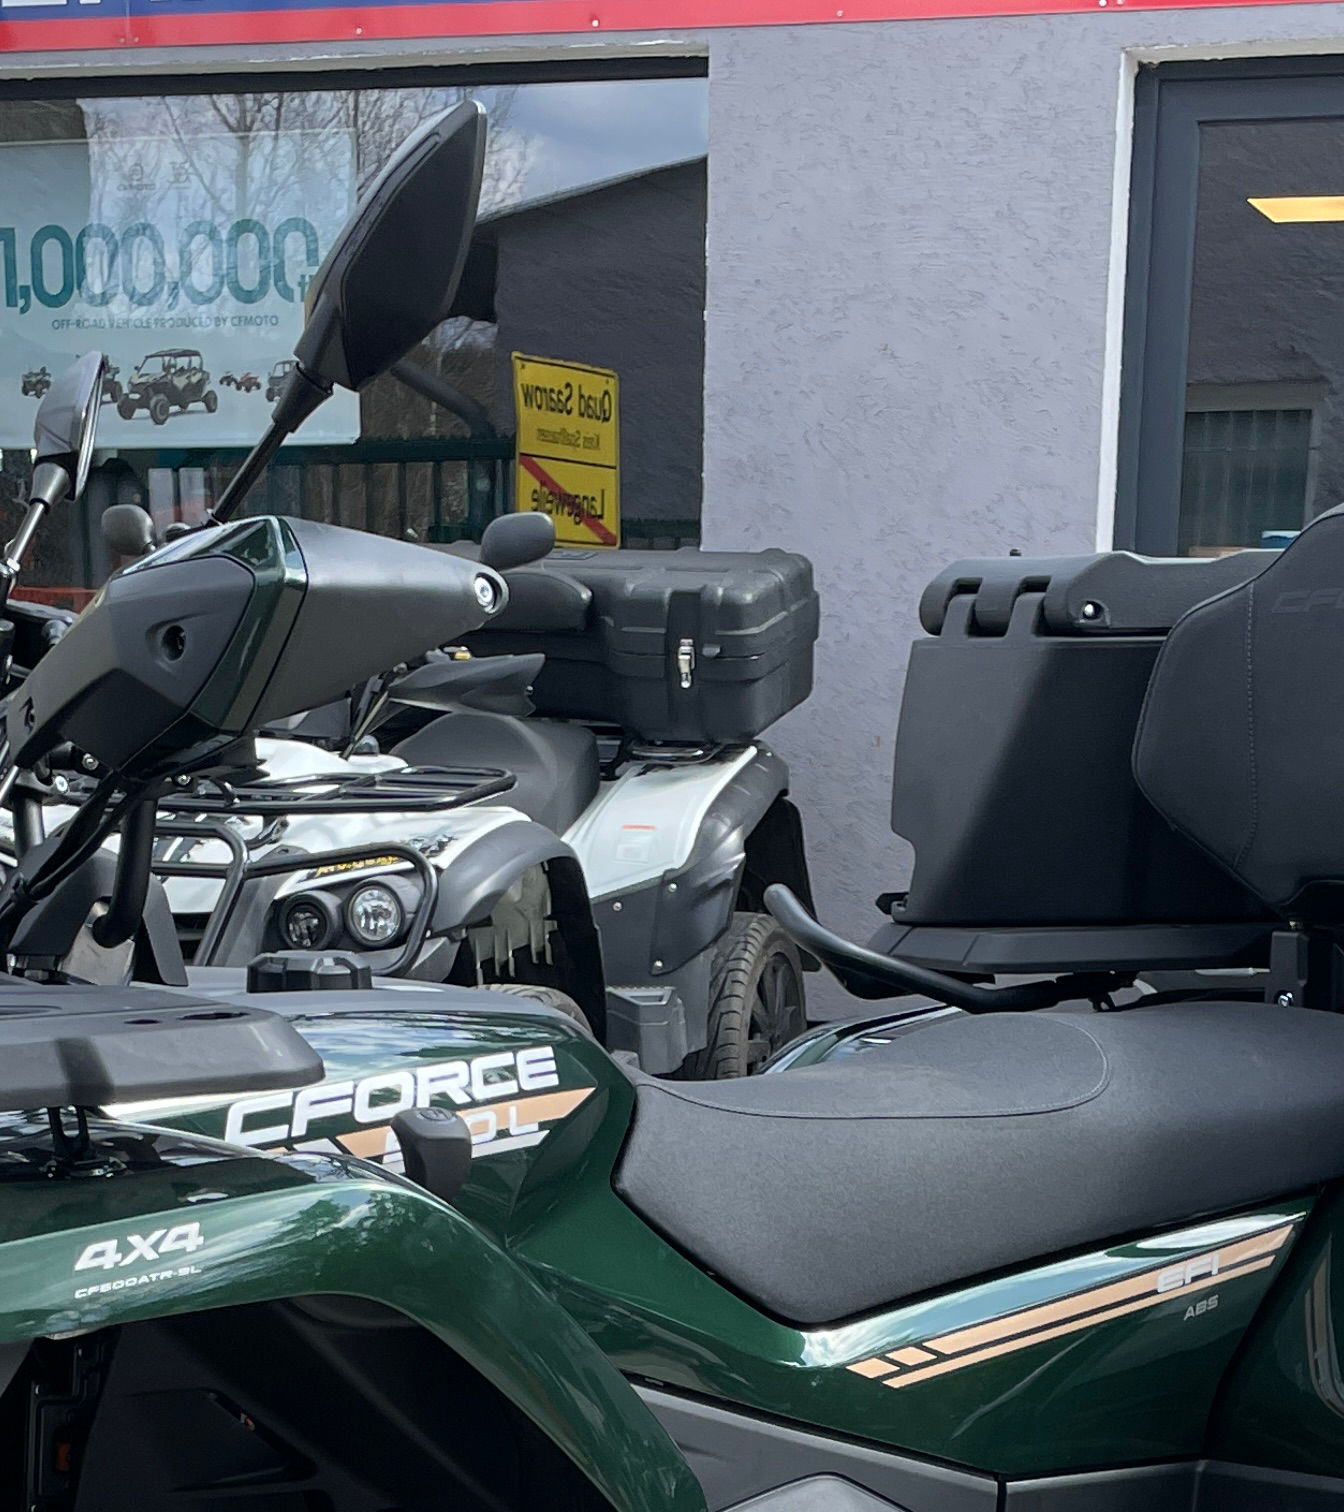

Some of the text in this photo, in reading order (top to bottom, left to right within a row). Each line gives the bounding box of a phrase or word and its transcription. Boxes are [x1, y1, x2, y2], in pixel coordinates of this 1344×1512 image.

[51, 318, 105, 330] OFF-ROAD
[214, 316, 228, 328] BY
[230, 315, 280, 328] CFMOTO
[224, 1046, 560, 1148] CFORCE
[1157, 1254, 1220, 1293] EFI
[1183, 1294, 1220, 1321] ABS
